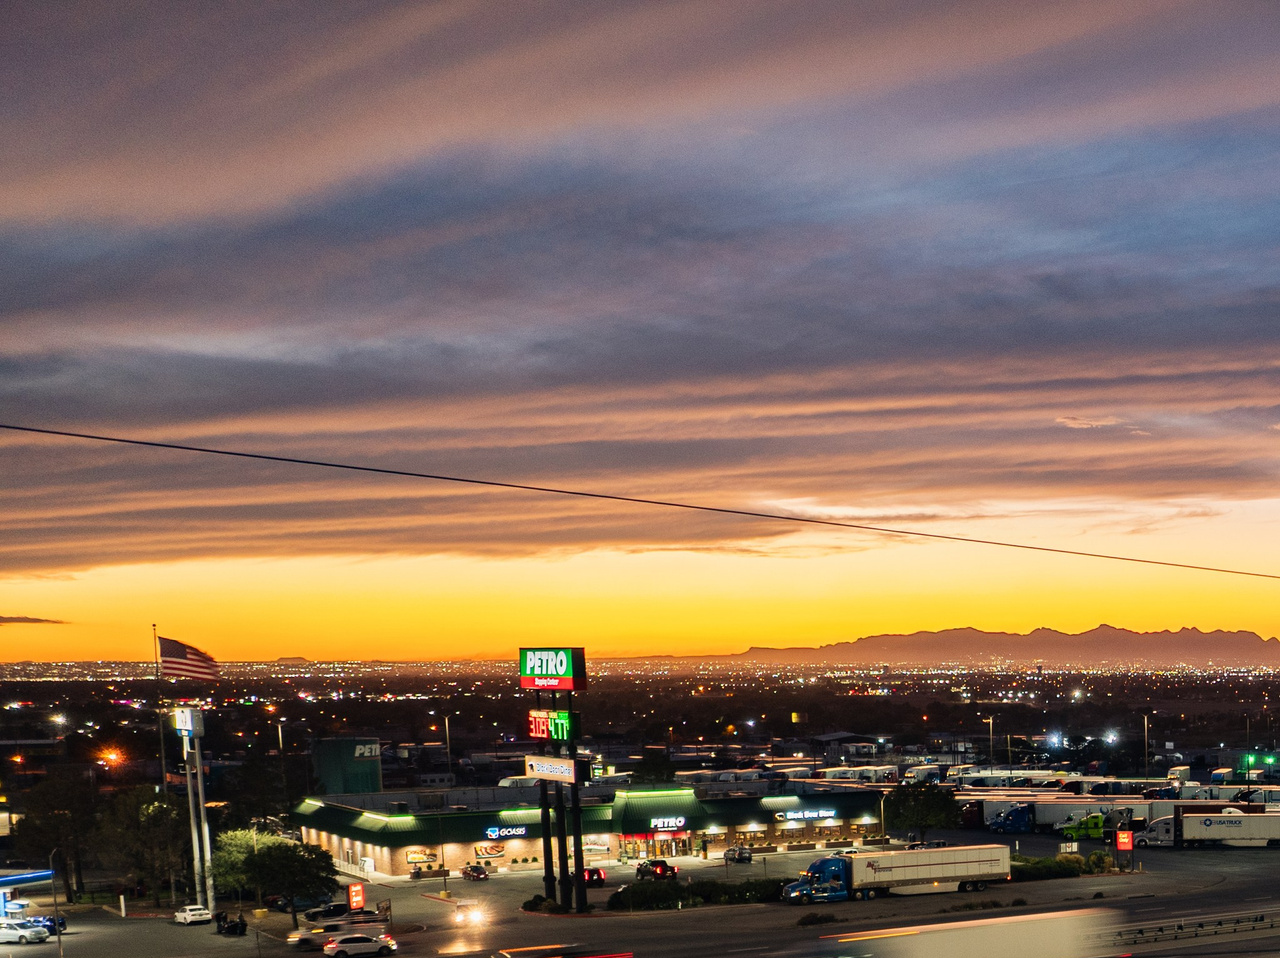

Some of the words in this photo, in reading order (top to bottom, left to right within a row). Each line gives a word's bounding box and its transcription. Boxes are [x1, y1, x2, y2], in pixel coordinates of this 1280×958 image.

[526, 651, 567, 675] PETRO
[650, 816, 686, 828] PETRO
[500, 827, 526, 837] GOASIS
